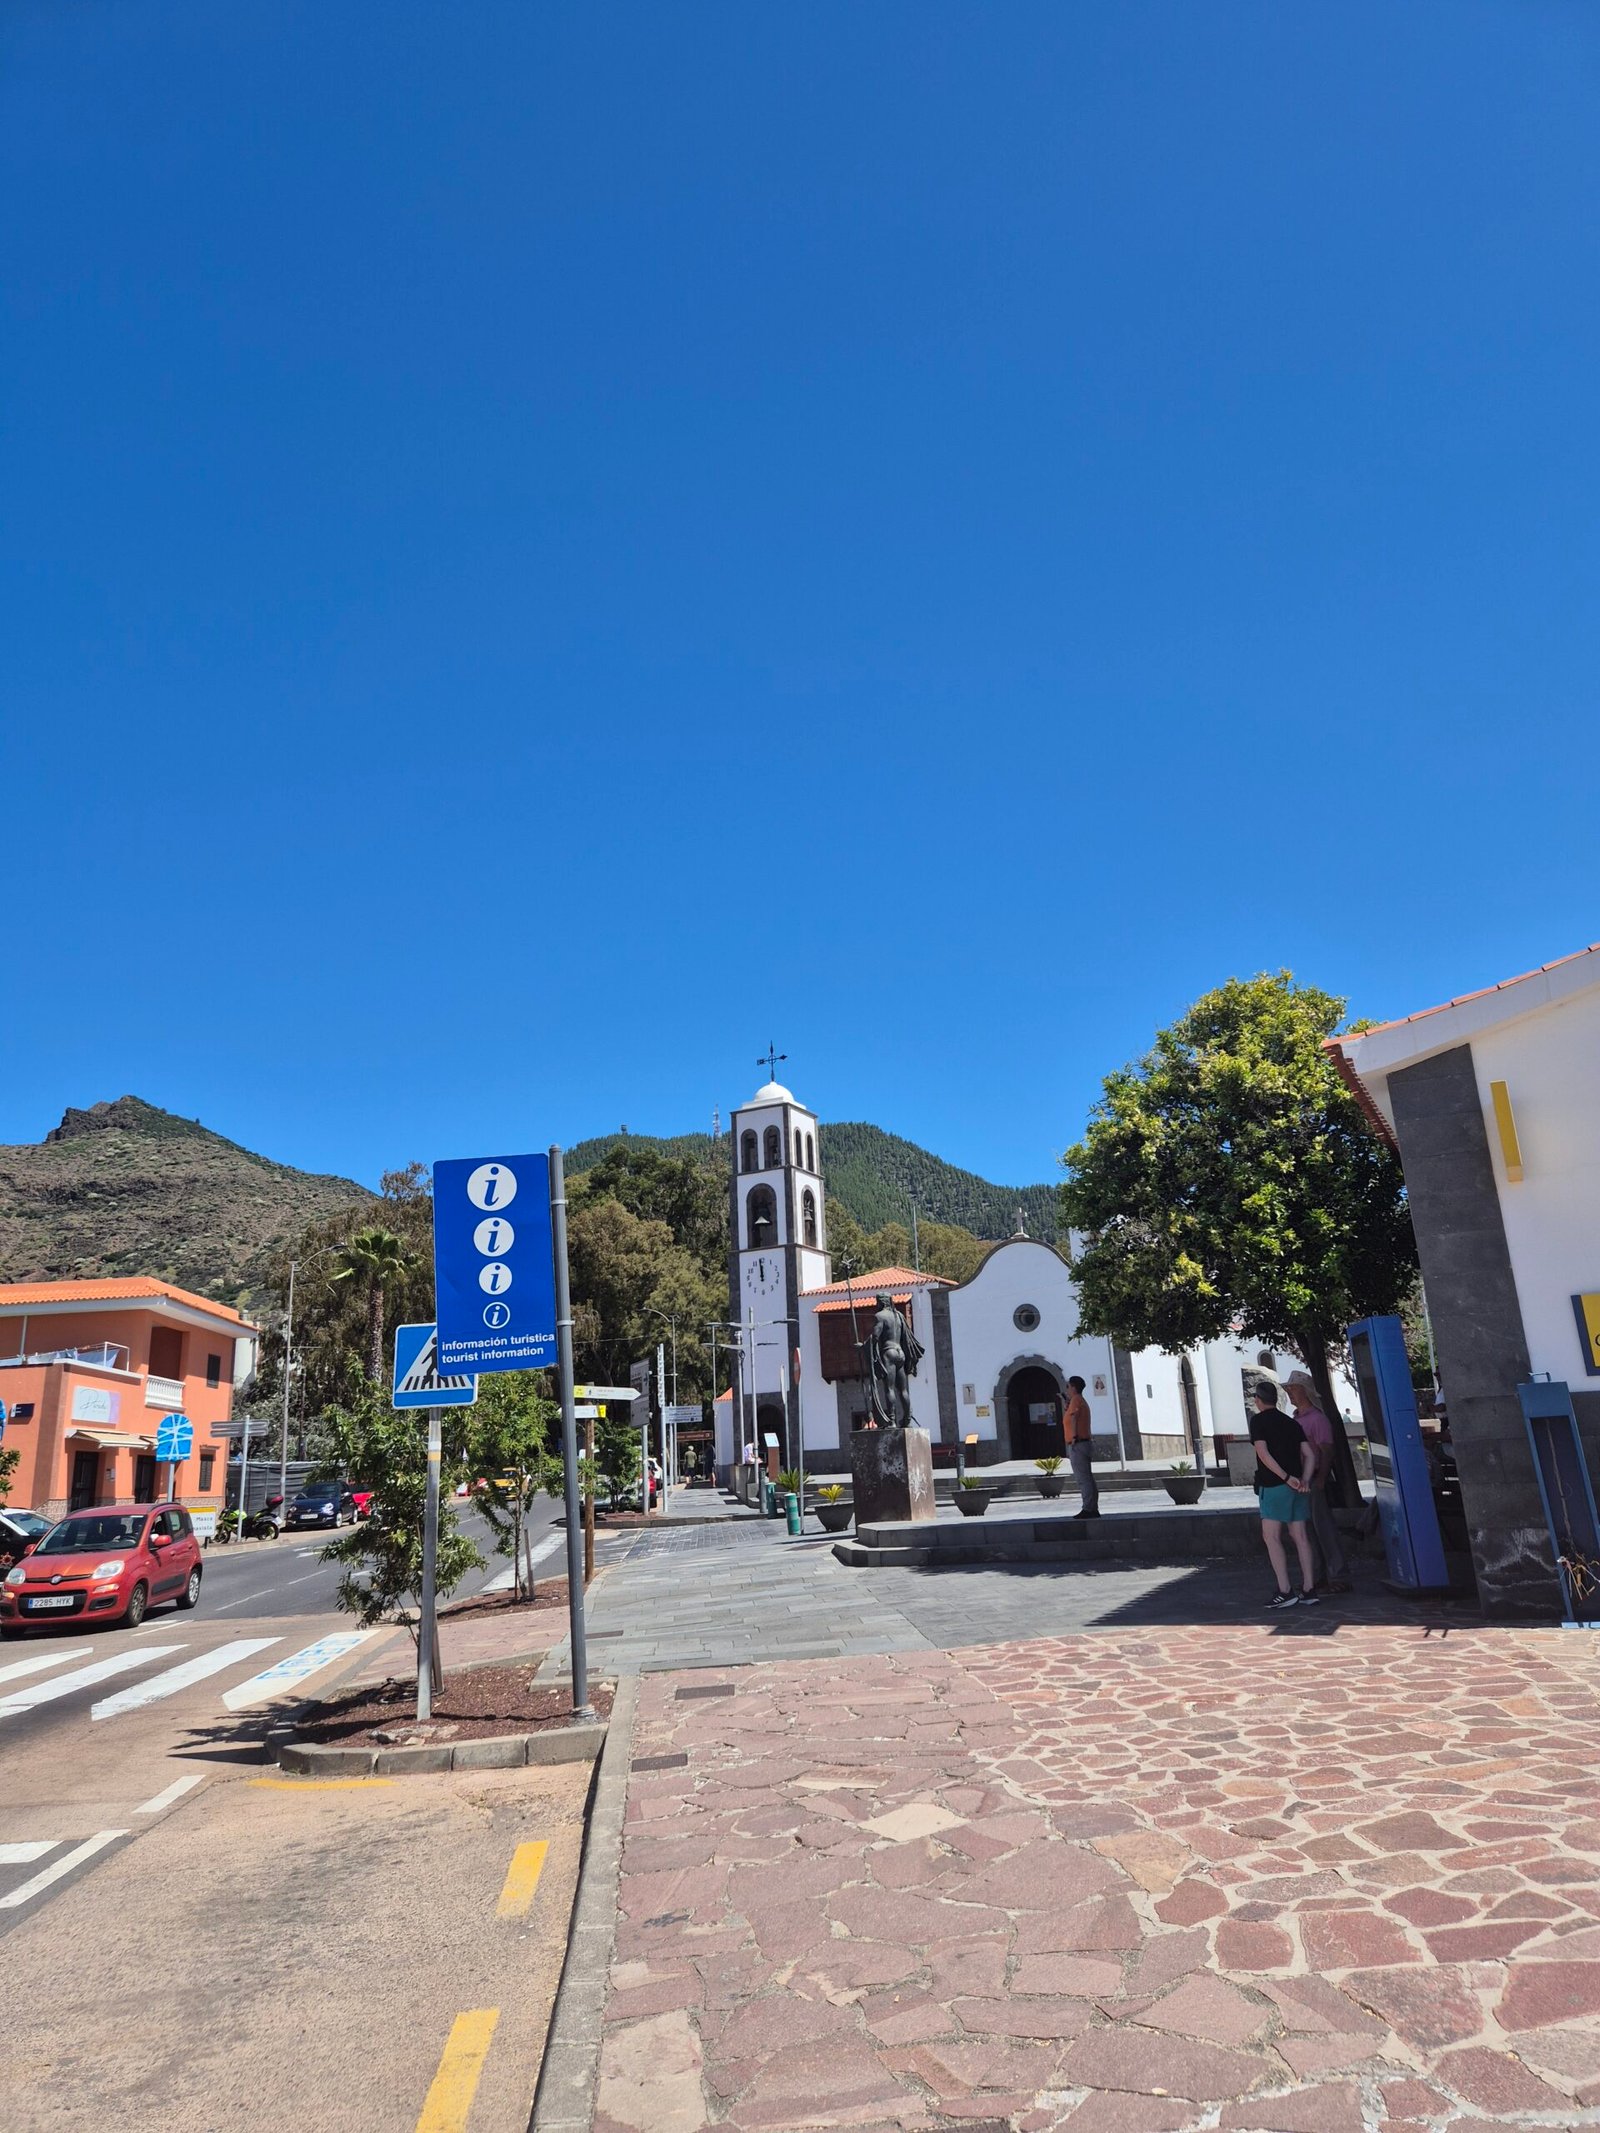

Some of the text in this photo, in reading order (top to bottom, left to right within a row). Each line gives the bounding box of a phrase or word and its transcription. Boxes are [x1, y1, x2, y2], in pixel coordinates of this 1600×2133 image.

[442, 1333, 555, 1351] información turística
[442, 1346, 544, 1364] tourist information
[34, 1597, 71, 1607] 2285 HYK
